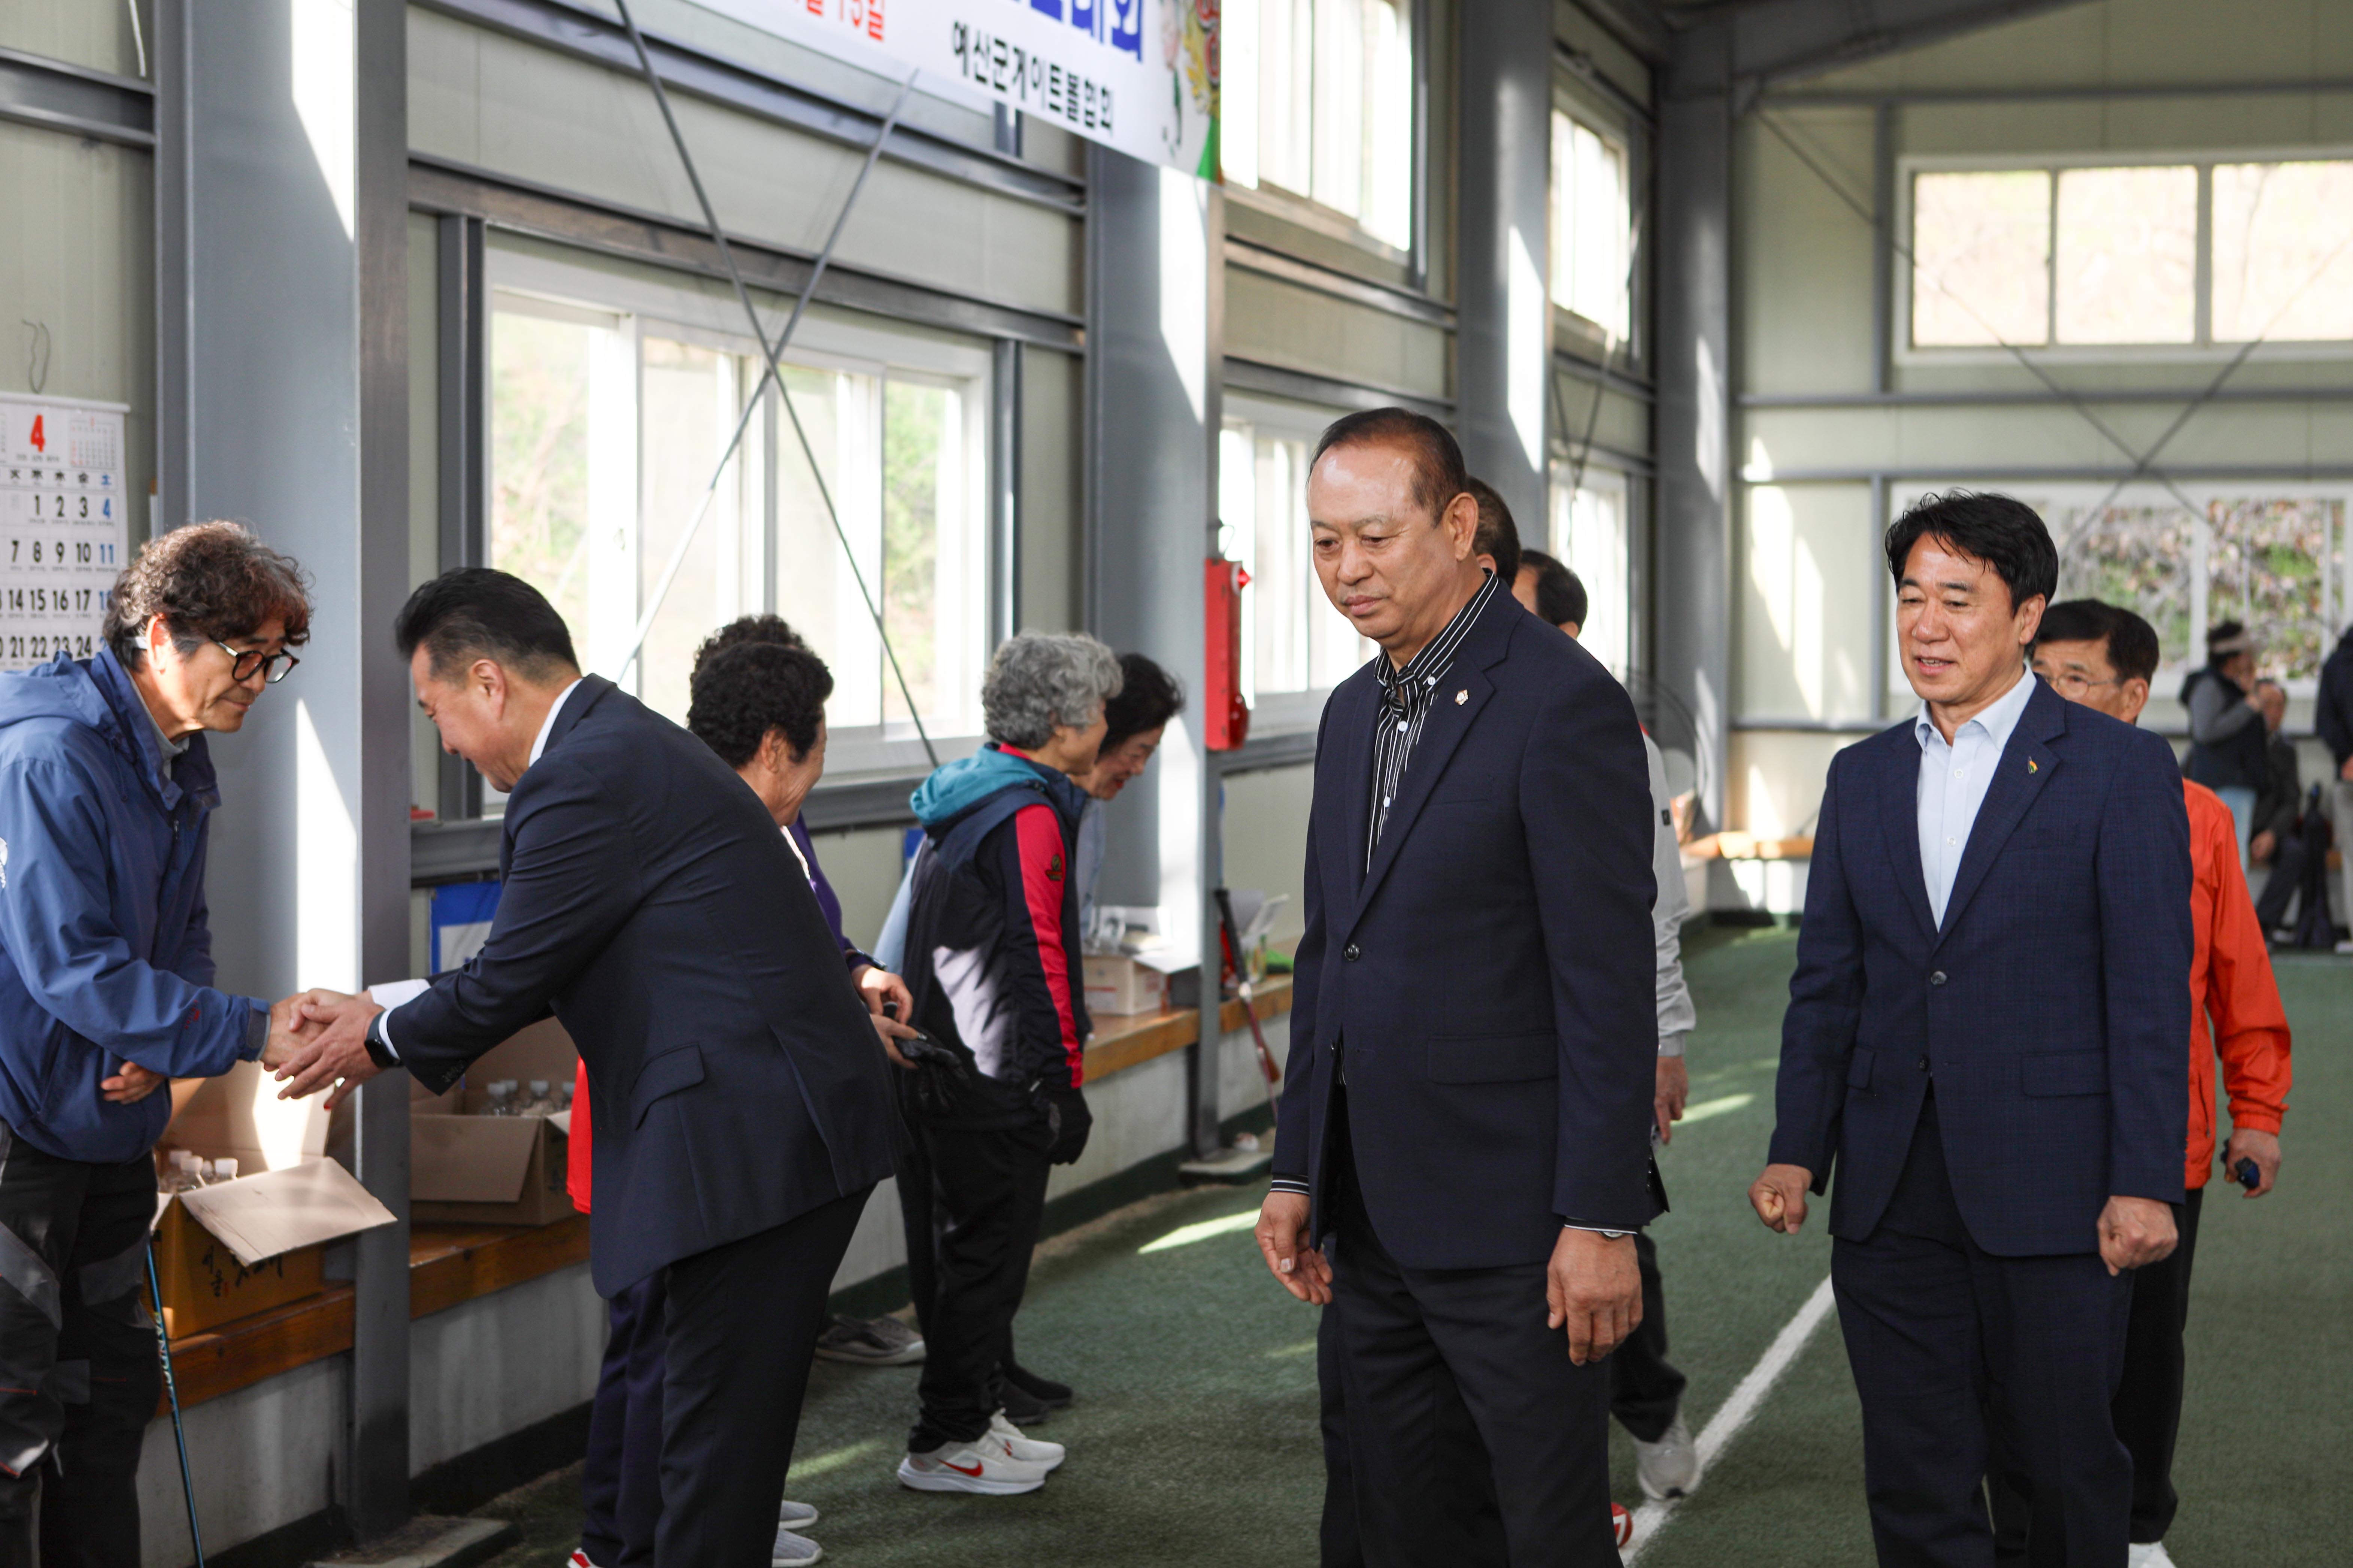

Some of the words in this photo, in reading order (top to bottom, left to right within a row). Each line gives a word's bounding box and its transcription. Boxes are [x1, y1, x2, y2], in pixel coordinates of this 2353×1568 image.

[30, 414, 45, 452] 4
[34, 495, 40, 516] 1
[56, 495, 64, 517] 2
[79, 496, 88, 518] 3
[103, 498, 111, 519] 4
[12, 540, 19, 562] 7
[33, 541, 42, 562] 8
[56, 542, 65, 563] 9
[76, 543, 91, 563] 10
[100, 544, 114, 564] 11
[9, 589, 24, 611] 14
[30, 589, 46, 611] 15
[53, 590, 69, 611] 16
[76, 589, 91, 611] 17
[10, 636, 24, 658] 21
[30, 636, 47, 658] 22
[76, 635, 91, 657] 24
